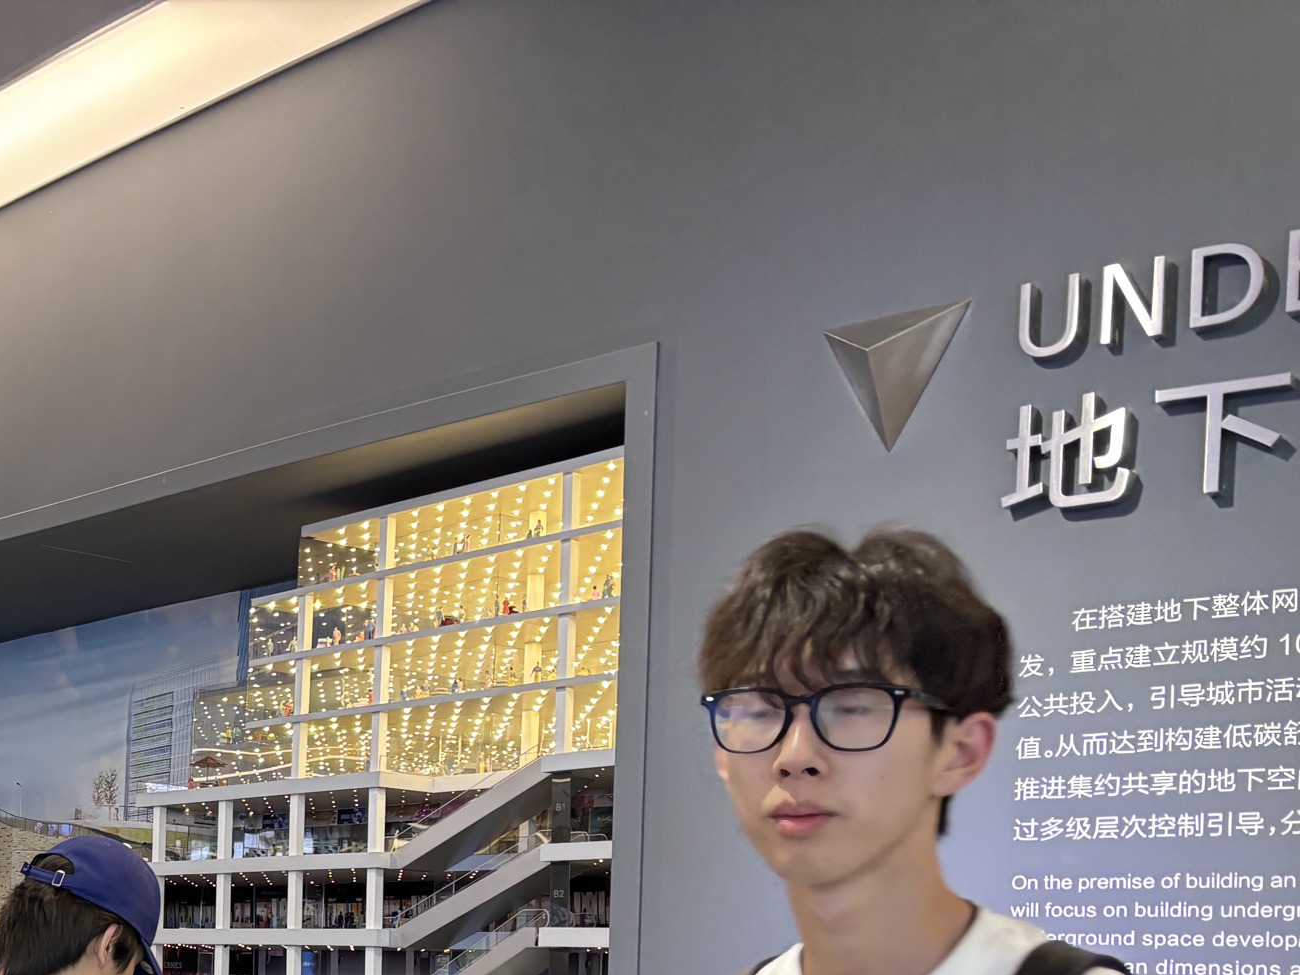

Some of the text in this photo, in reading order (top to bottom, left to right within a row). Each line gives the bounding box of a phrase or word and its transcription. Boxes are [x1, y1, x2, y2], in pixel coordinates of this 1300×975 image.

[1018, 229, 1300, 358] UND
[1002, 372, 1296, 509] 地下
[1071, 588, 1298, 632] 在搭建地下整体网
[1018, 634, 1268, 679] 发，重点建立规模约
[1014, 765, 1300, 801] 推进集约共享的地下空
[555, 802, 566, 811] B1
[553, 890, 565, 898] B2
[1011, 873, 1296, 893] On the premise of building an
[1010, 902, 1300, 922] will focus on building underg
[1042, 930, 1135, 947] erground
[1141, 932, 1205, 951] space
